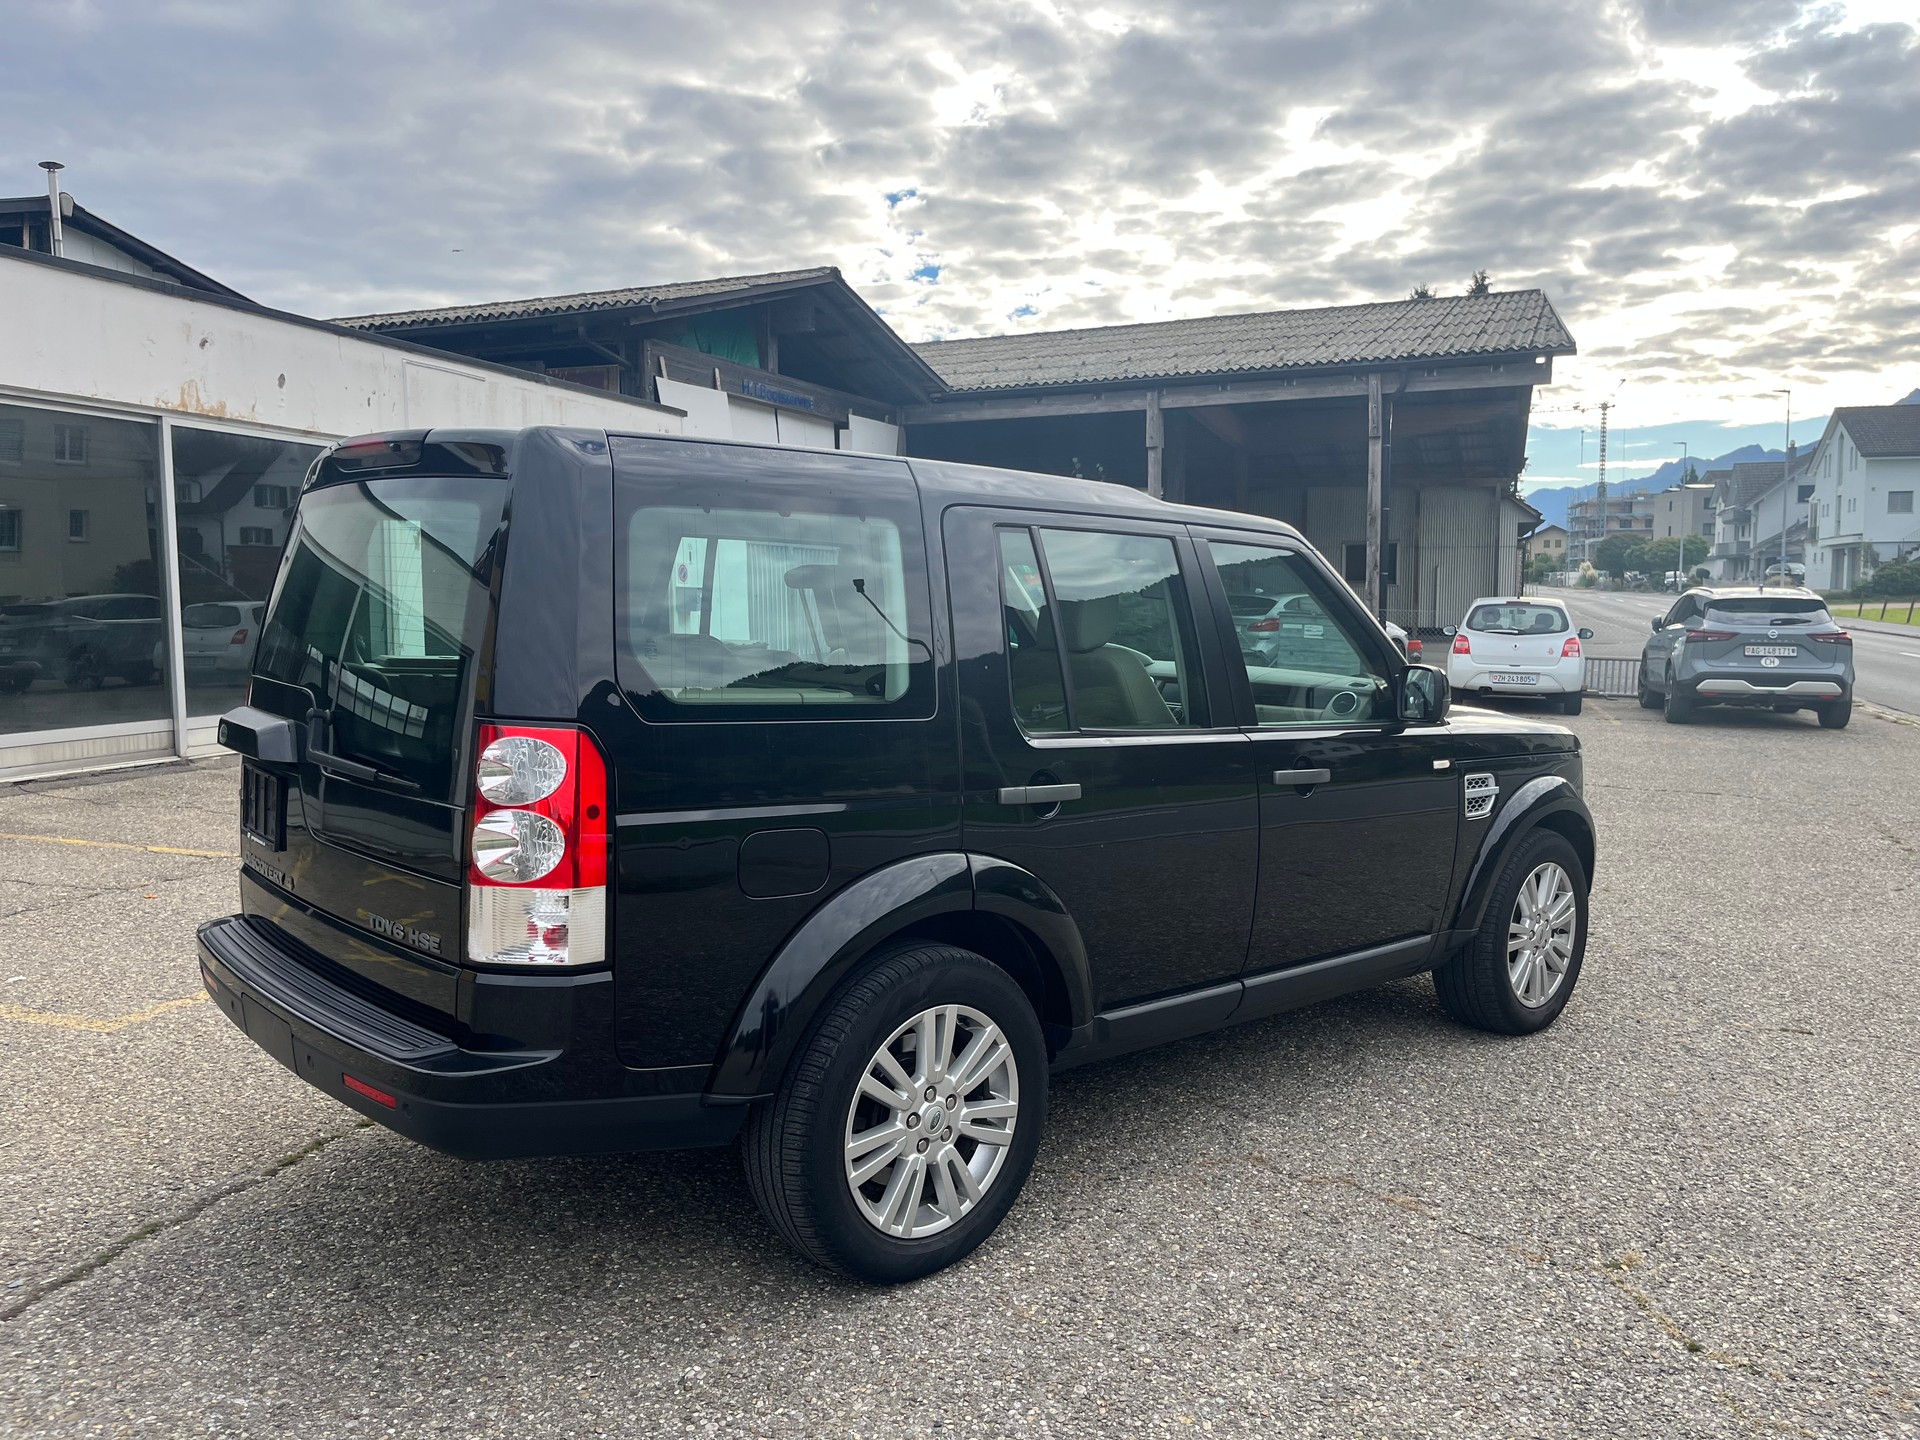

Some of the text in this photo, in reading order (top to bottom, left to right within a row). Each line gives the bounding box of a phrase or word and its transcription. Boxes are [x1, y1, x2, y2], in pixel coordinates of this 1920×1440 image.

[1764, 658, 1775, 666] CH
[368, 911, 443, 955] TDV6 HSE
